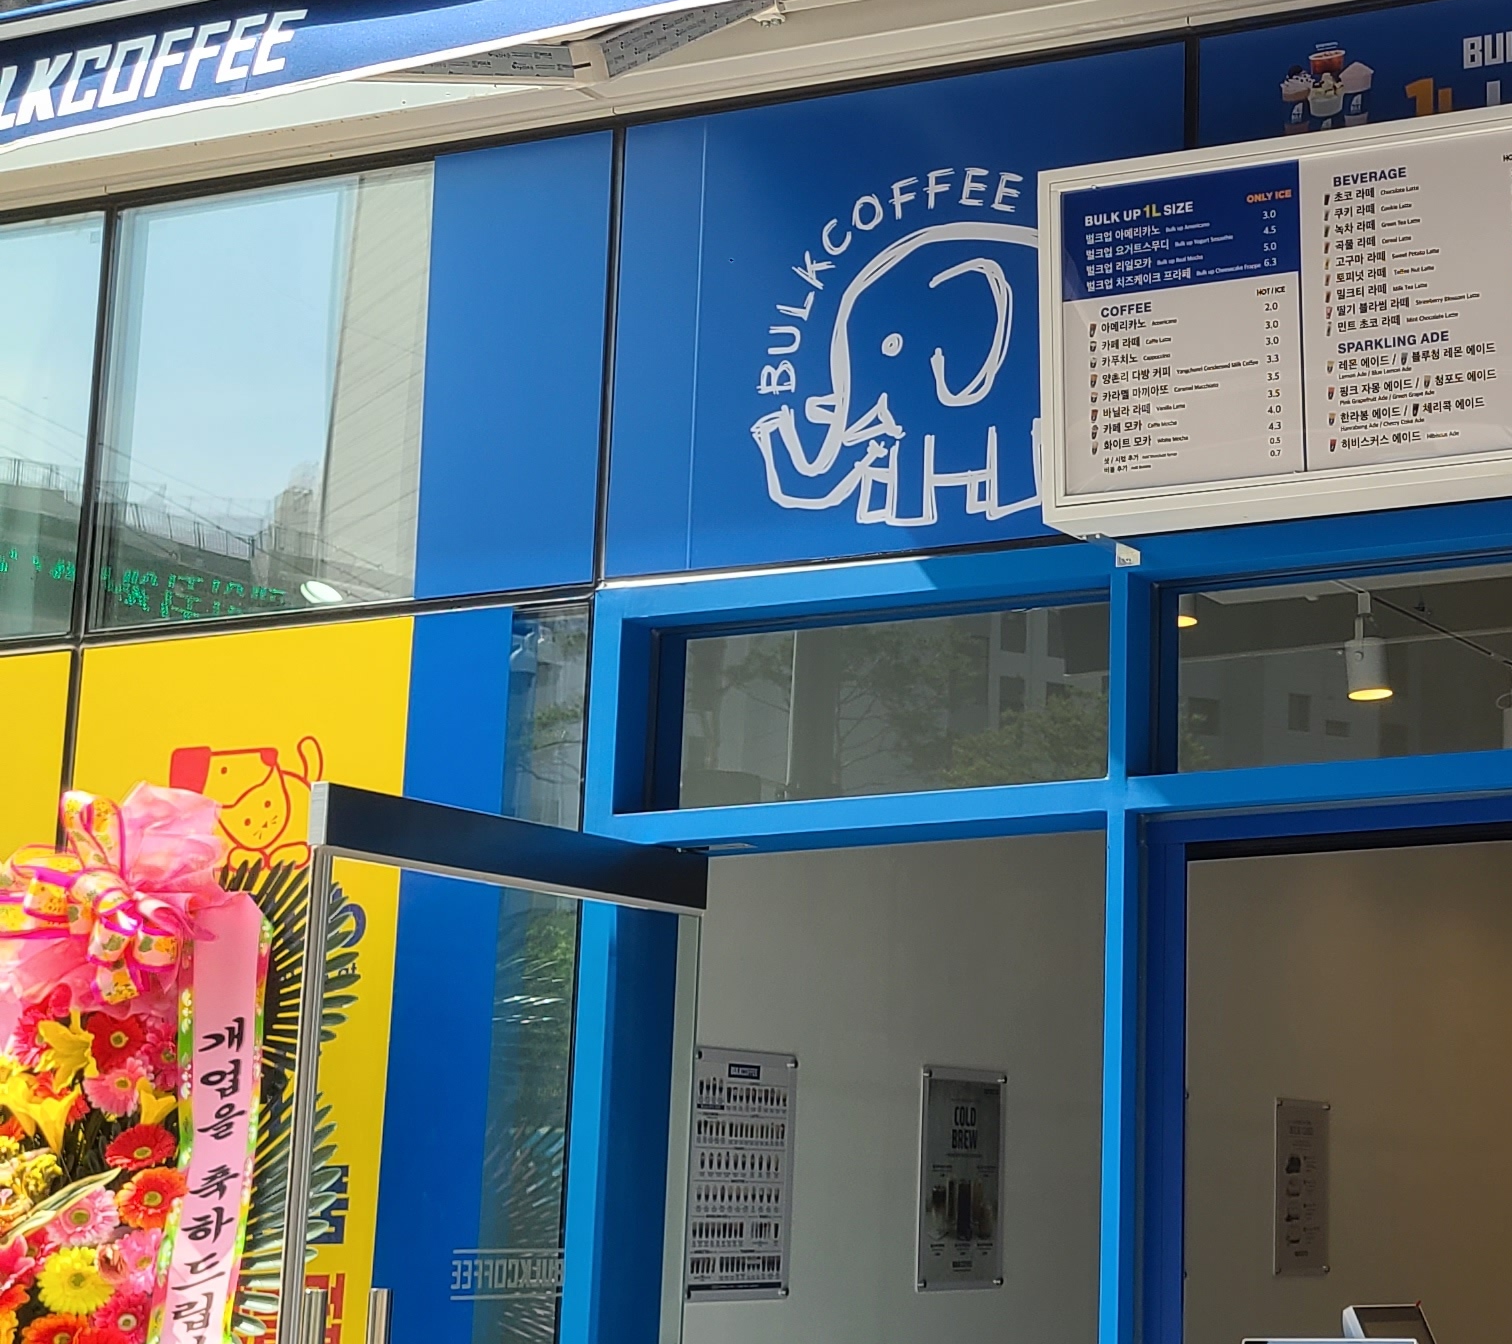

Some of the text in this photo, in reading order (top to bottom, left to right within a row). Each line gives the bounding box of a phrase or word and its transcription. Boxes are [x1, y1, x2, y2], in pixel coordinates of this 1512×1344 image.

[1333, 167, 1407, 187] BEVERAGE
[1246, 189, 1292, 204] ONLY ICE
[1334, 191, 1352, 203] 초코
[1084, 201, 1193, 227] BULK UP 1L SIZE
[1262, 210, 1276, 220] 3.0
[1086, 225, 1160, 244] 벌크업 아메리카노
[1263, 225, 1277, 235] 4.5
[1086, 239, 1169, 260] 벌크업 요거트스무디
[1263, 241, 1277, 251] 5.0
[1086, 263, 1112, 276] 벌크업
[1264, 258, 1277, 267] 6.3
[756, 168, 1023, 394] BULKCOFFEE
[1086, 279, 1113, 292] 벌크업
[1116, 272, 1161, 288] 치즈케이크
[1101, 302, 1152, 318] COFFEE
[1264, 302, 1278, 312] 2.0
[1101, 319, 1147, 333] 아메리카노
[1338, 331, 1449, 354] SPARKLING ADE
[1101, 353, 1138, 367] 카푸치노
[197, 1017, 247, 1141] 개업을
[954, 1106, 977, 1127] COLD
[952, 1129, 978, 1149] BREW
